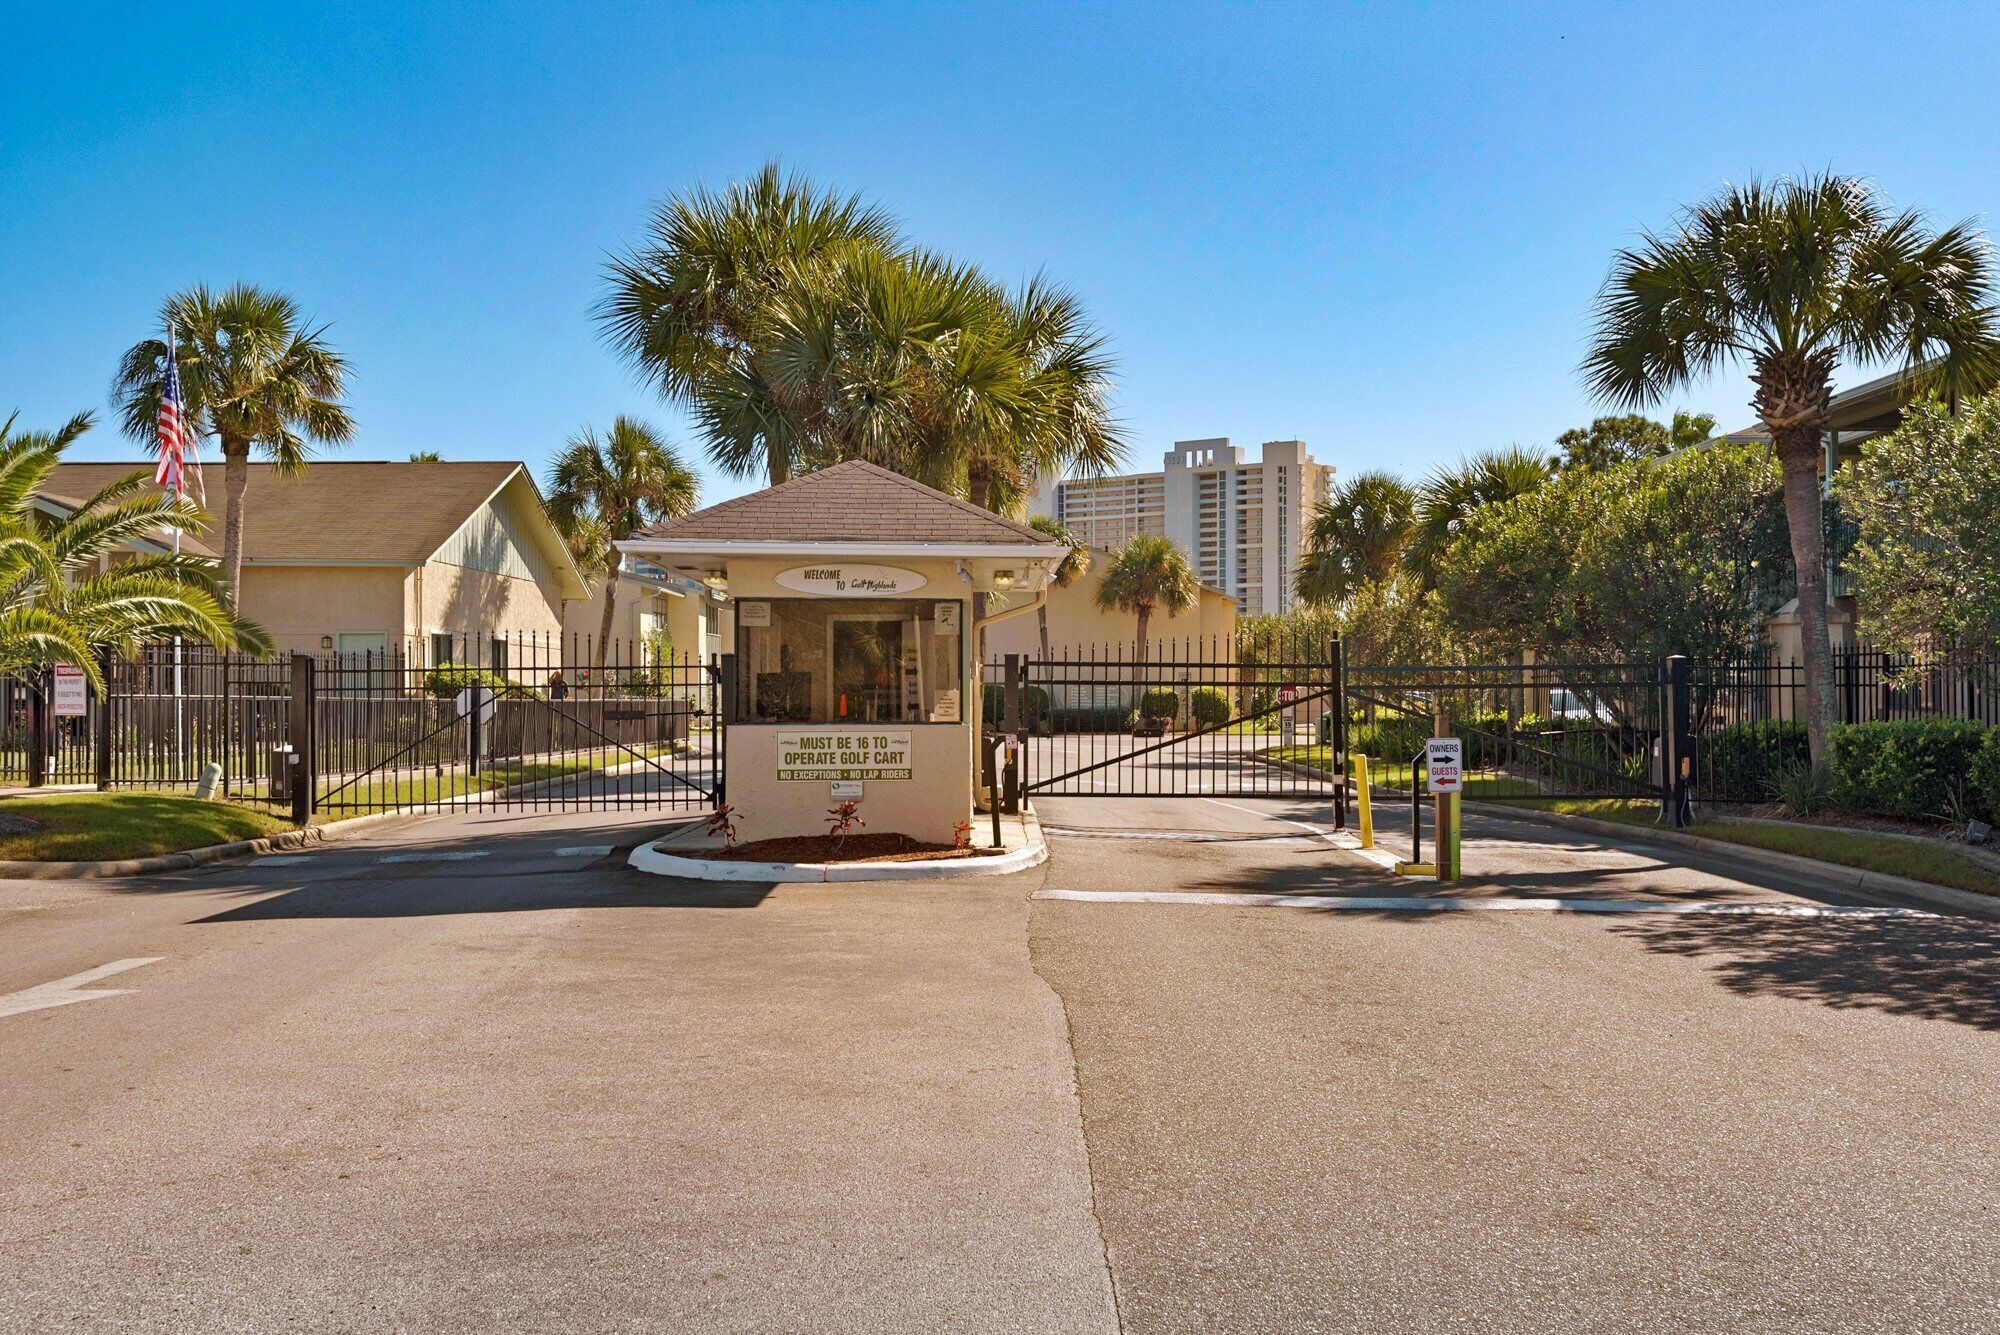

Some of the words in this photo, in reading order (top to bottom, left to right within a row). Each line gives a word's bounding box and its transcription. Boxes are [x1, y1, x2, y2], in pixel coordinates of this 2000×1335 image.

[804, 569, 841, 580] WELCOME
[836, 580, 846, 590] TO
[800, 737, 833, 749] MUST
[836, 737, 851, 749] BE
[856, 737, 869, 749] 16
[873, 737, 888, 749] TO
[1429, 744, 1459, 752] OWNERS
[784, 752, 836, 765] OPERATE
[840, 752, 869, 764] GOLF
[874, 752, 905, 764] CART
[780, 770, 792, 780] NO
[794, 770, 841, 779] EXCEPTIONS
[850, 770, 861, 779] NO
[863, 770, 879, 779] LAP
[881, 770, 909, 779] RIDERS
[1431, 767, 1458, 775] GUESTS
